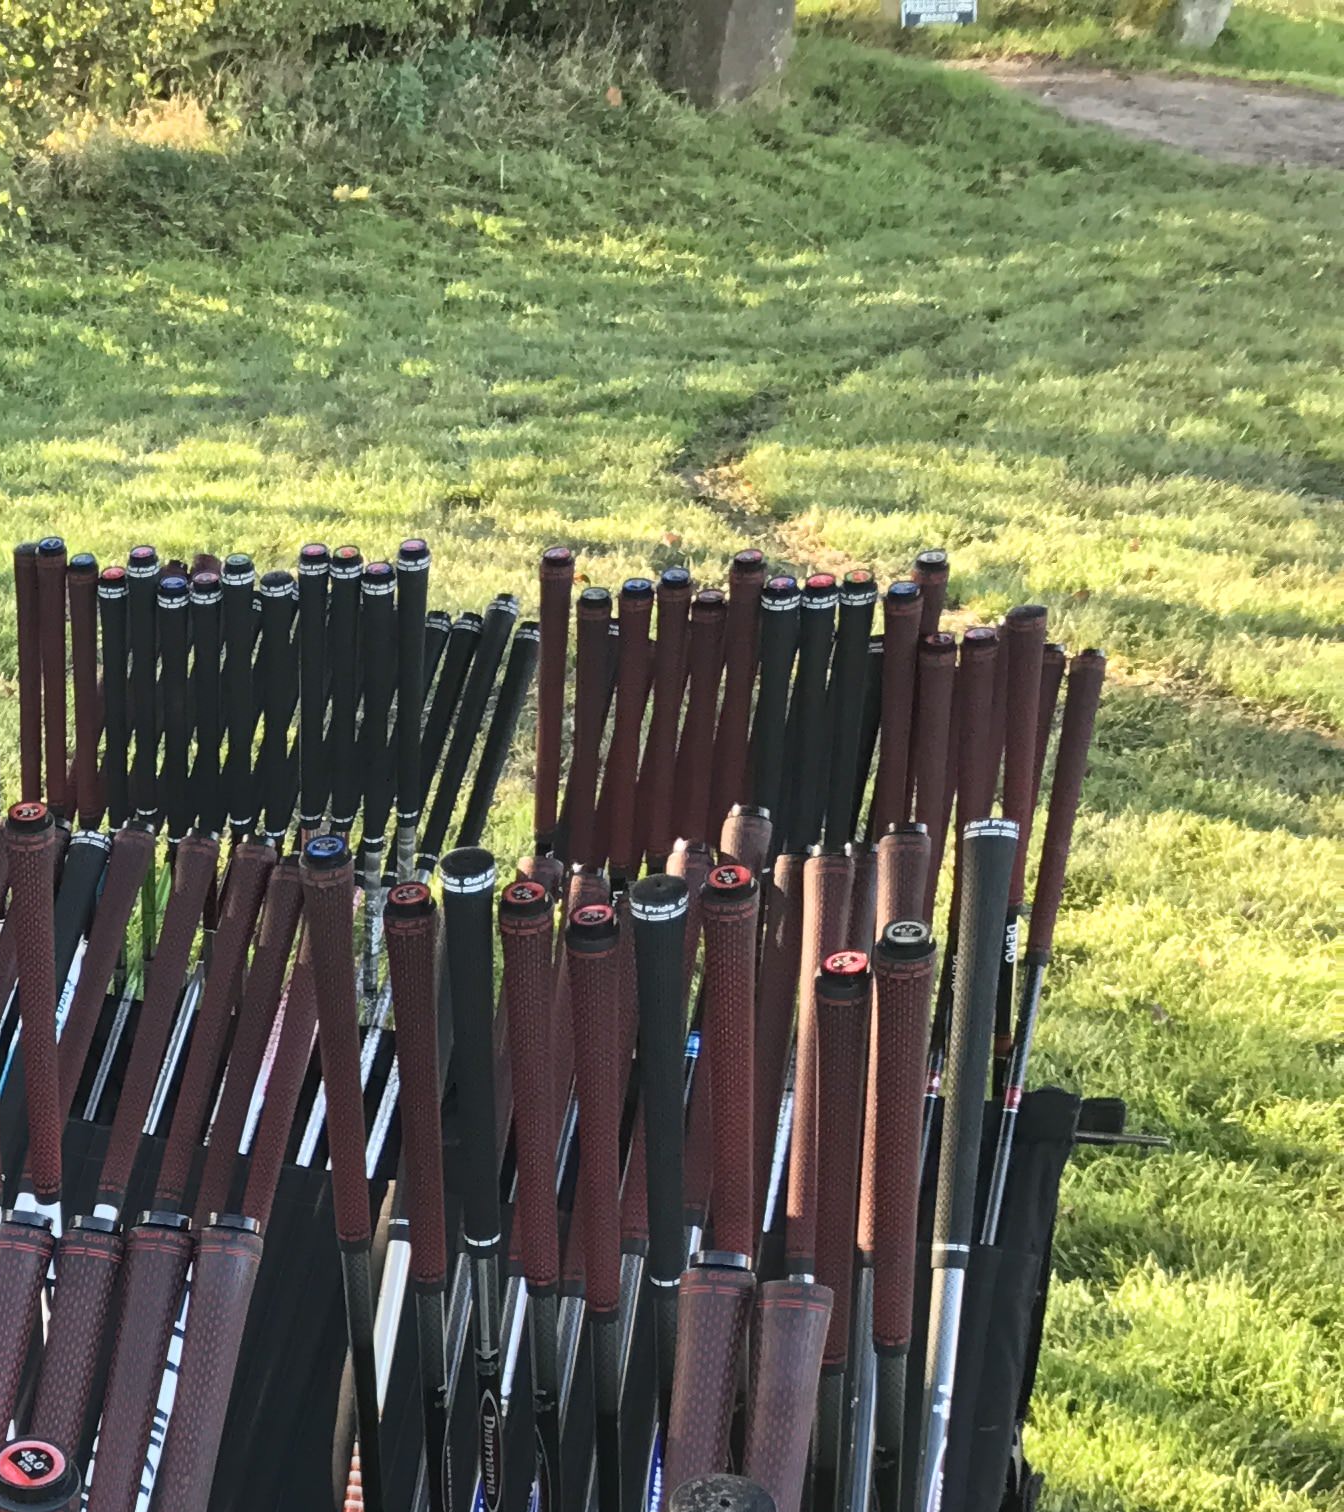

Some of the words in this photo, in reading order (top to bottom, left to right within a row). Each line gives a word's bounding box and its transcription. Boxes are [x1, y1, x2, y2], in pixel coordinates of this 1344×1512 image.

[1005, 923, 1017, 963] DEMO
[20, 1451, 50, 1472] 45.0"
[483, 1415, 496, 1495] Diamana
